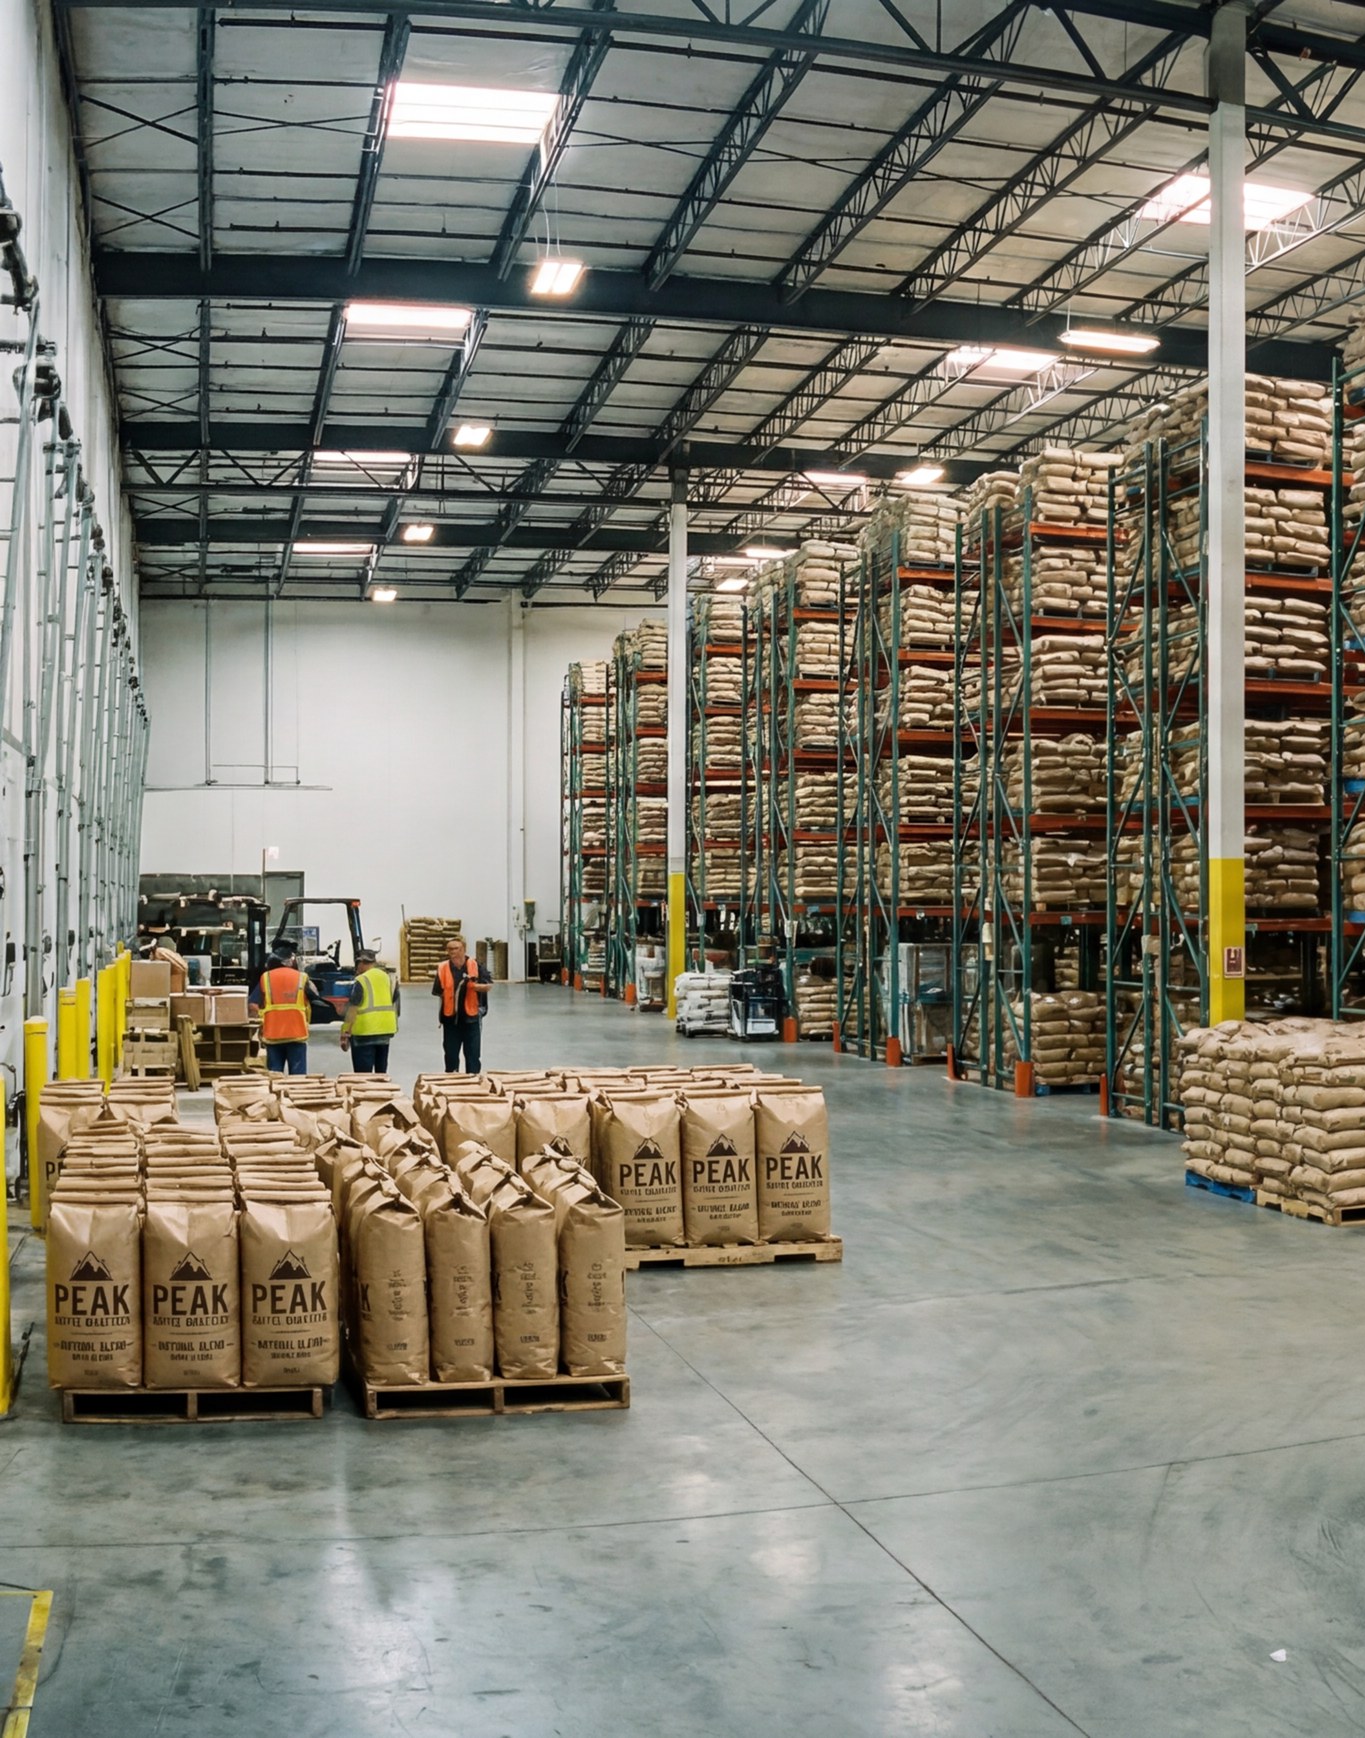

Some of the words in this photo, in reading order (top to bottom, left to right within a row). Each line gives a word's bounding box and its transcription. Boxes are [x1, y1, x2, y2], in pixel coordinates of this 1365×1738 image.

[620, 1161, 677, 1187] PEAK
[693, 1159, 750, 1184] PEAK
[766, 1154, 822, 1180] PEAK
[55, 1284, 130, 1316] PEAK
[153, 1284, 228, 1316] PEAK
[252, 1281, 327, 1314] PEAK
